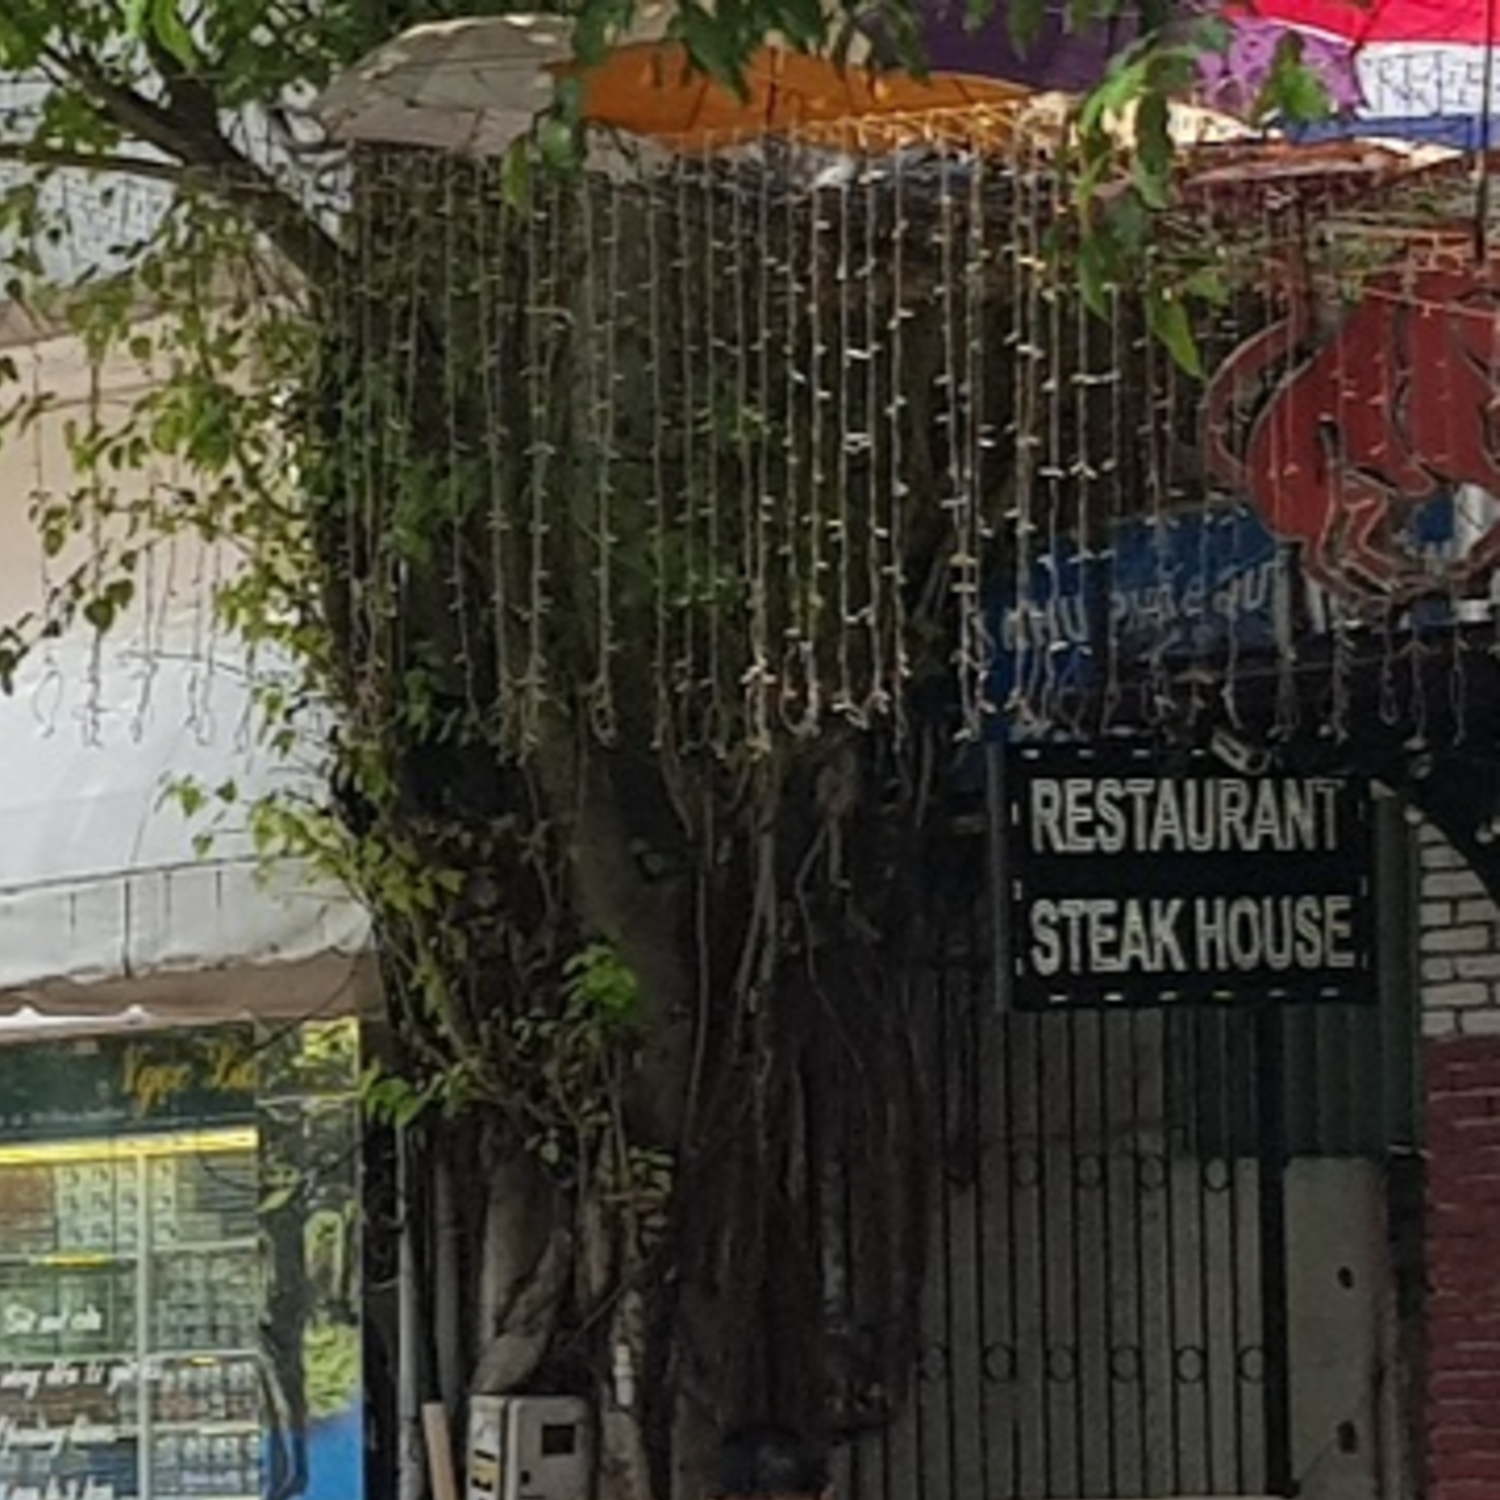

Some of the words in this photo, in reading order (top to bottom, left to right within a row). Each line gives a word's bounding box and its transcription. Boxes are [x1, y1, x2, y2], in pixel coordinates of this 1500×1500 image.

[1030, 777, 1346, 853] RESTAURANT
[1030, 898, 1188, 975] STEAK
[1194, 895, 1356, 972] HOUSE
